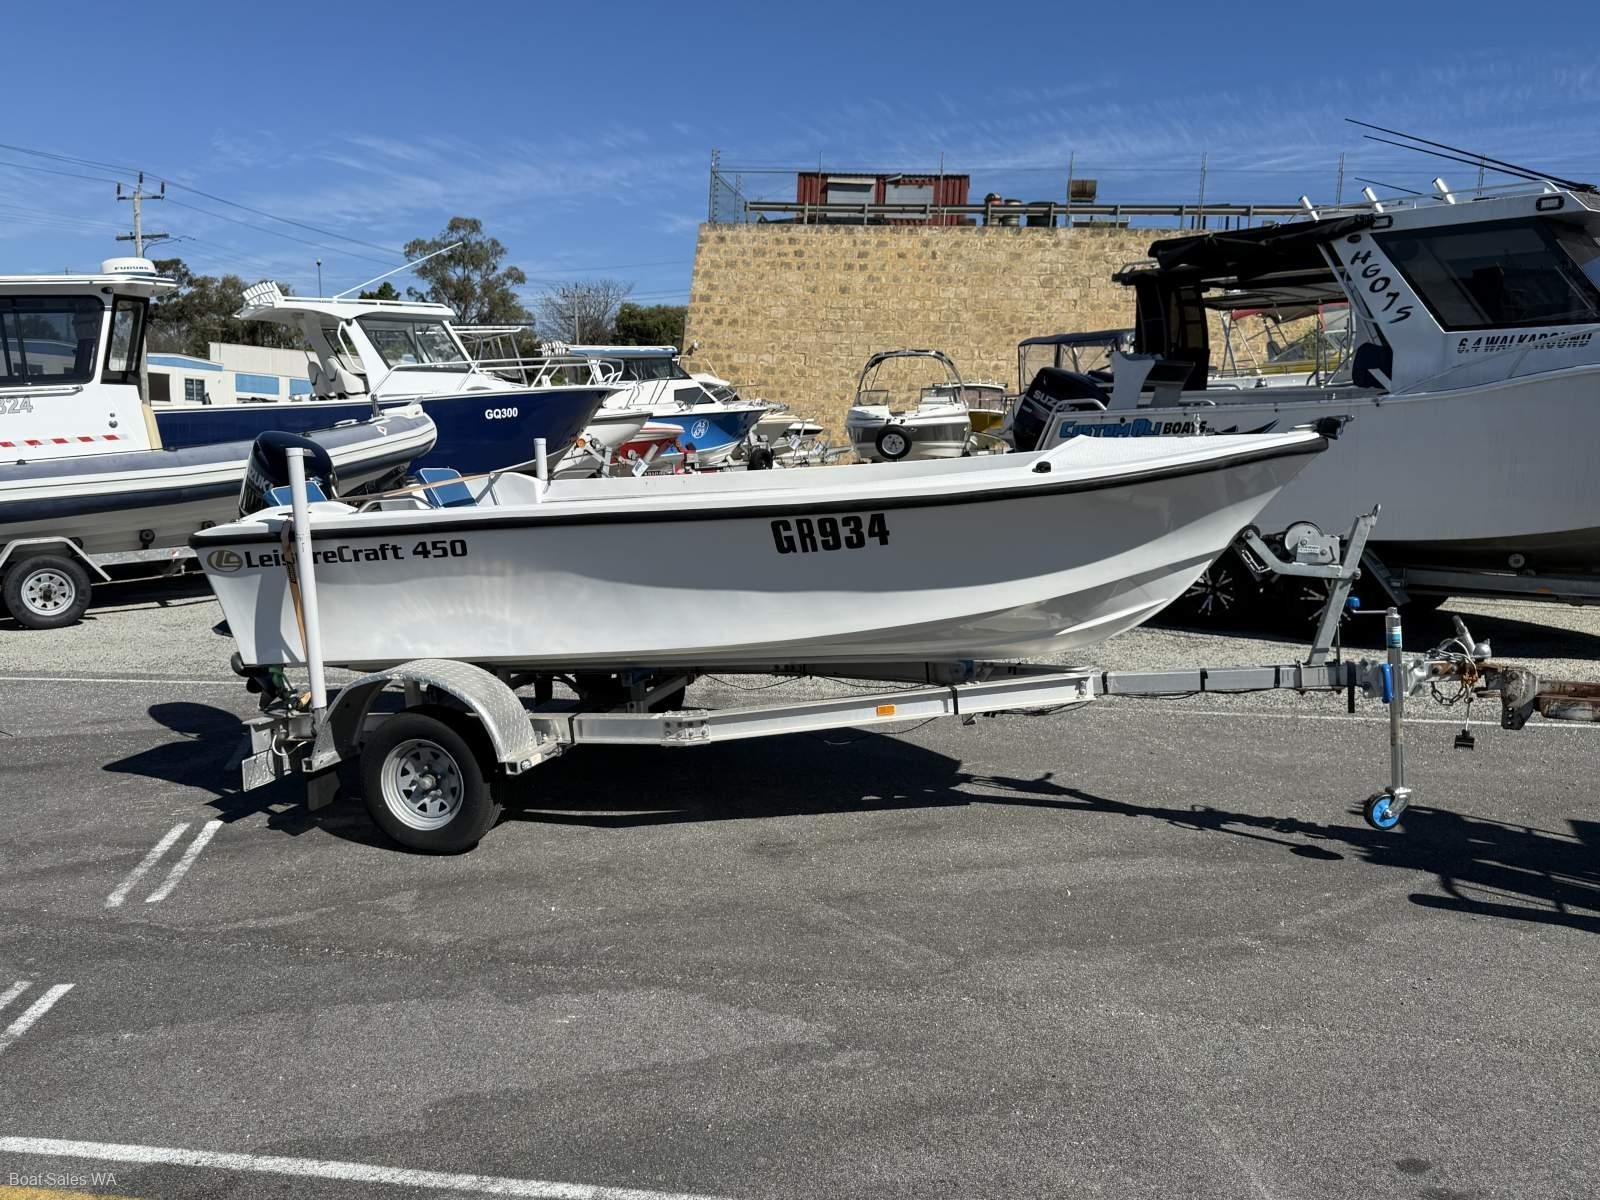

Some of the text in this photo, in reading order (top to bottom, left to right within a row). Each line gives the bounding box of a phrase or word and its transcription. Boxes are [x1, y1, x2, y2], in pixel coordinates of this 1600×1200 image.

[484, 407, 519, 420] GQ300
[770, 512, 890, 555] GR934
[245, 542, 405, 569] LeireCraft
[412, 539, 468, 560] 450
